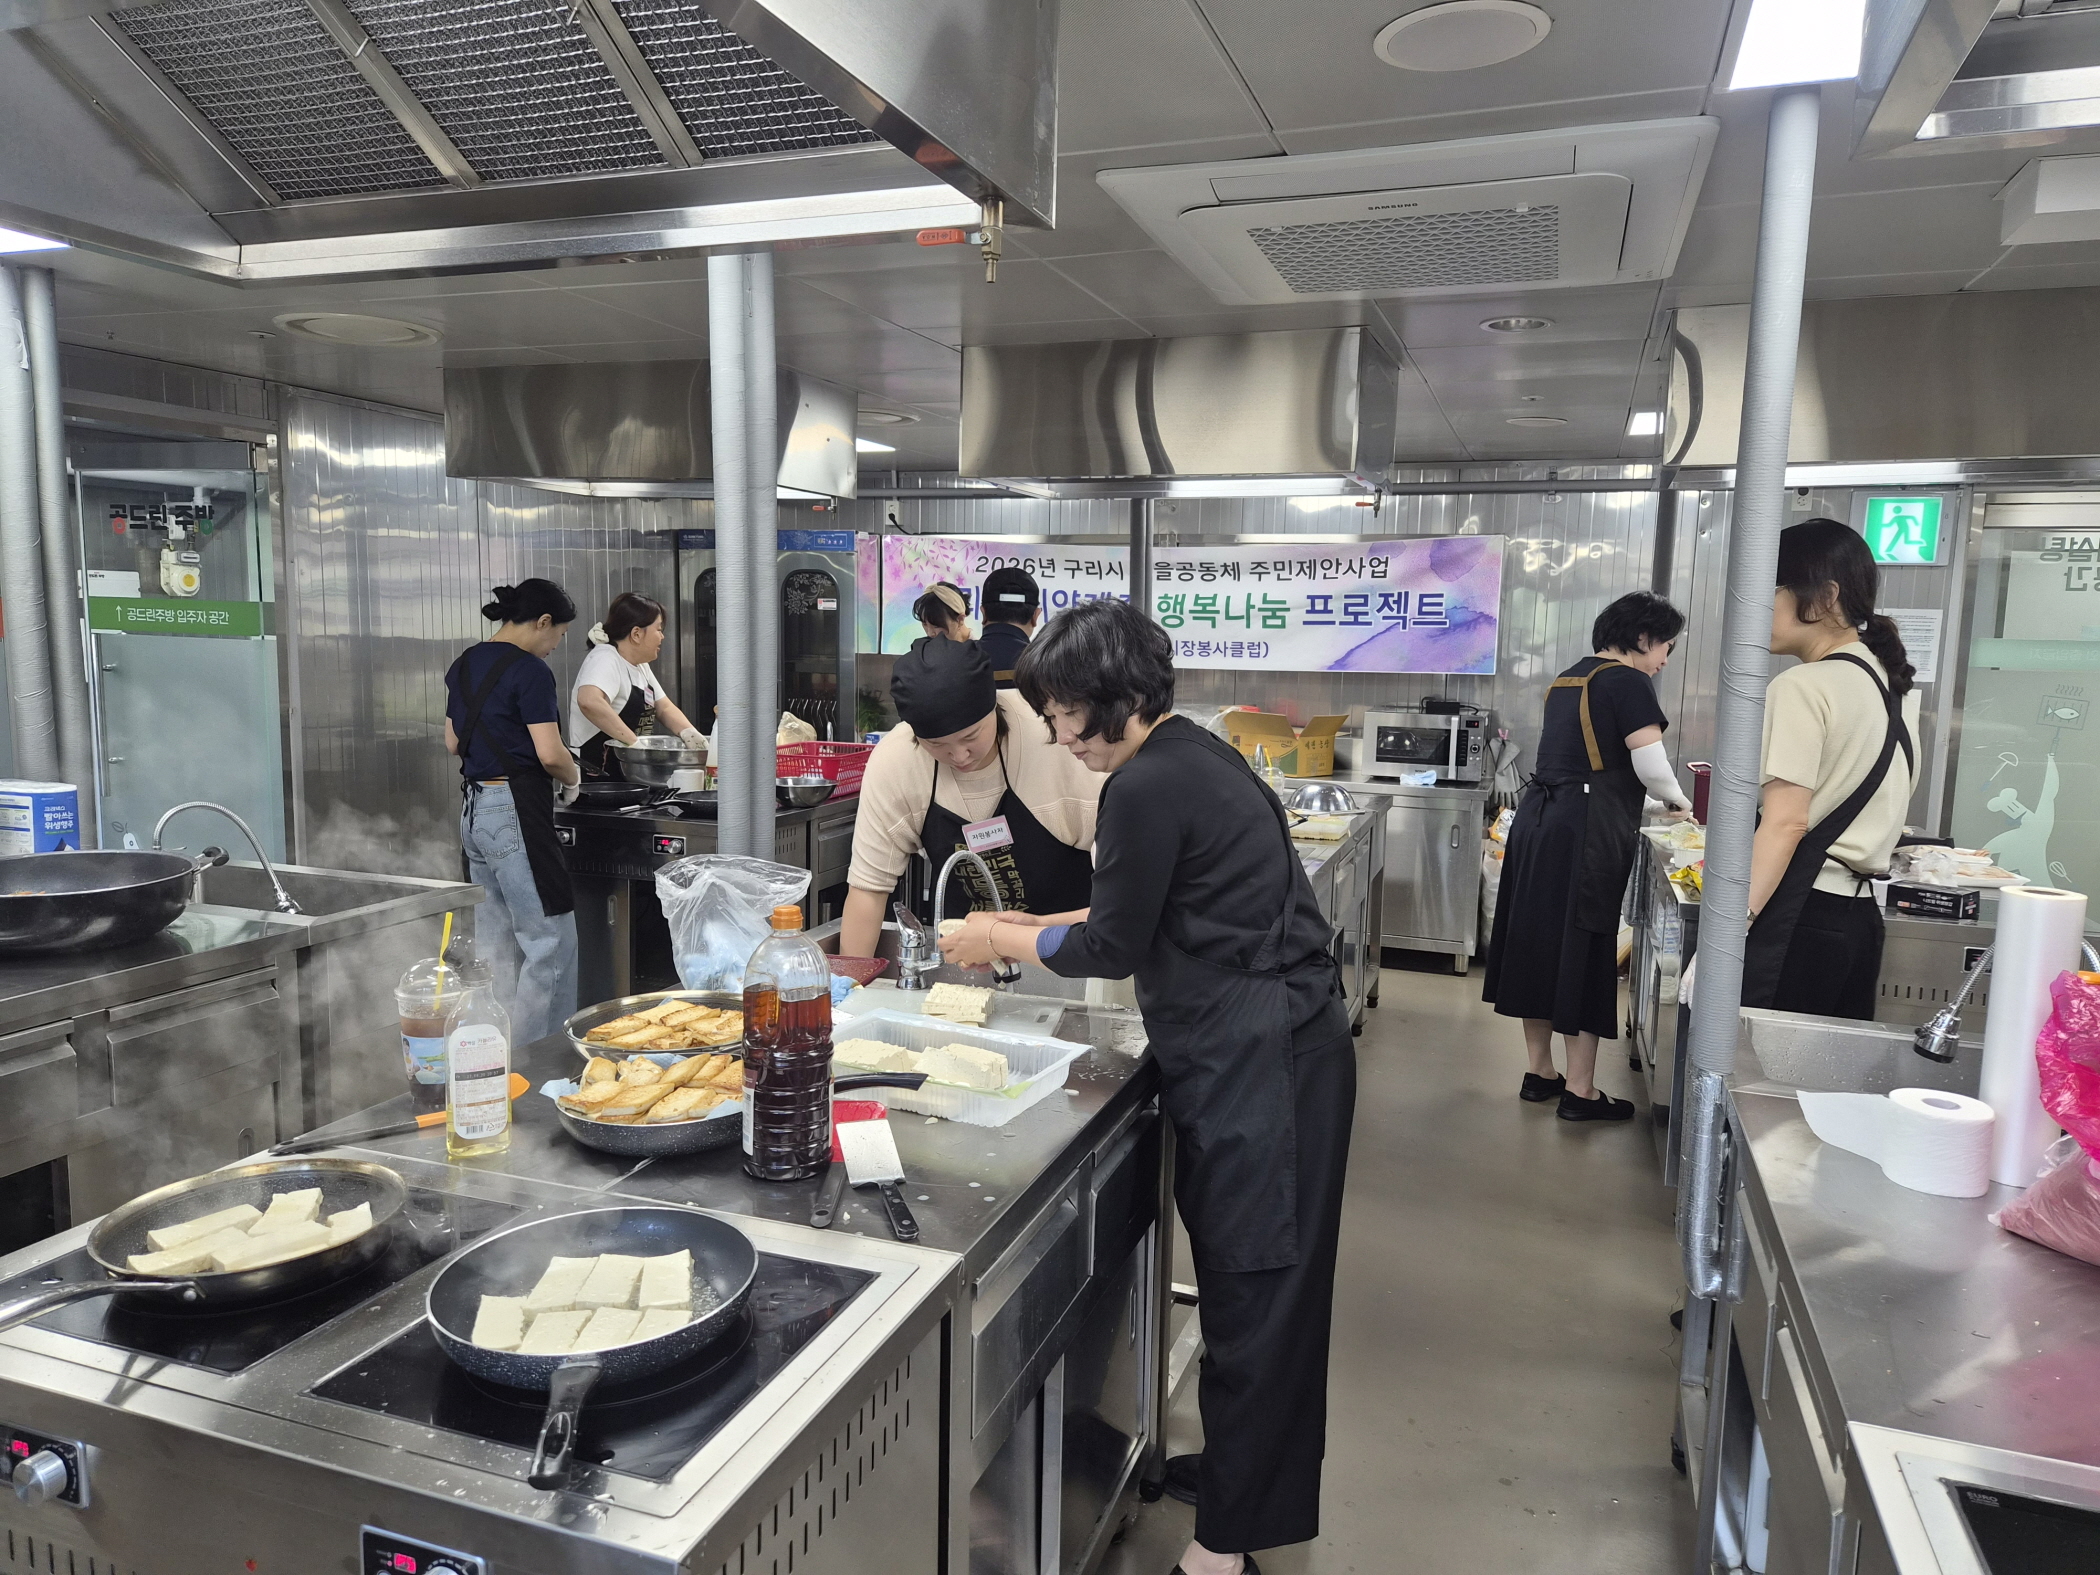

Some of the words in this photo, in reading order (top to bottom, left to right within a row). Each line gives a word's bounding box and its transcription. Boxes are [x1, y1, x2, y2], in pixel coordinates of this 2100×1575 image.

[1368, 203, 1418, 211] SAMSUNG
[975, 556, 1056, 579] 2026년
[1063, 559, 1125, 580] 구리시
[1153, 561, 1241, 582] 을공동체
[1249, 556, 1390, 581] 주민제안사업
[127, 607, 175, 623] 공드린주방
[176, 609, 206, 624] 입주자
[209, 611, 229, 625] 공간
[1157, 592, 1291, 630] 행복나눔
[1302, 590, 1450, 631] 프로젝트
